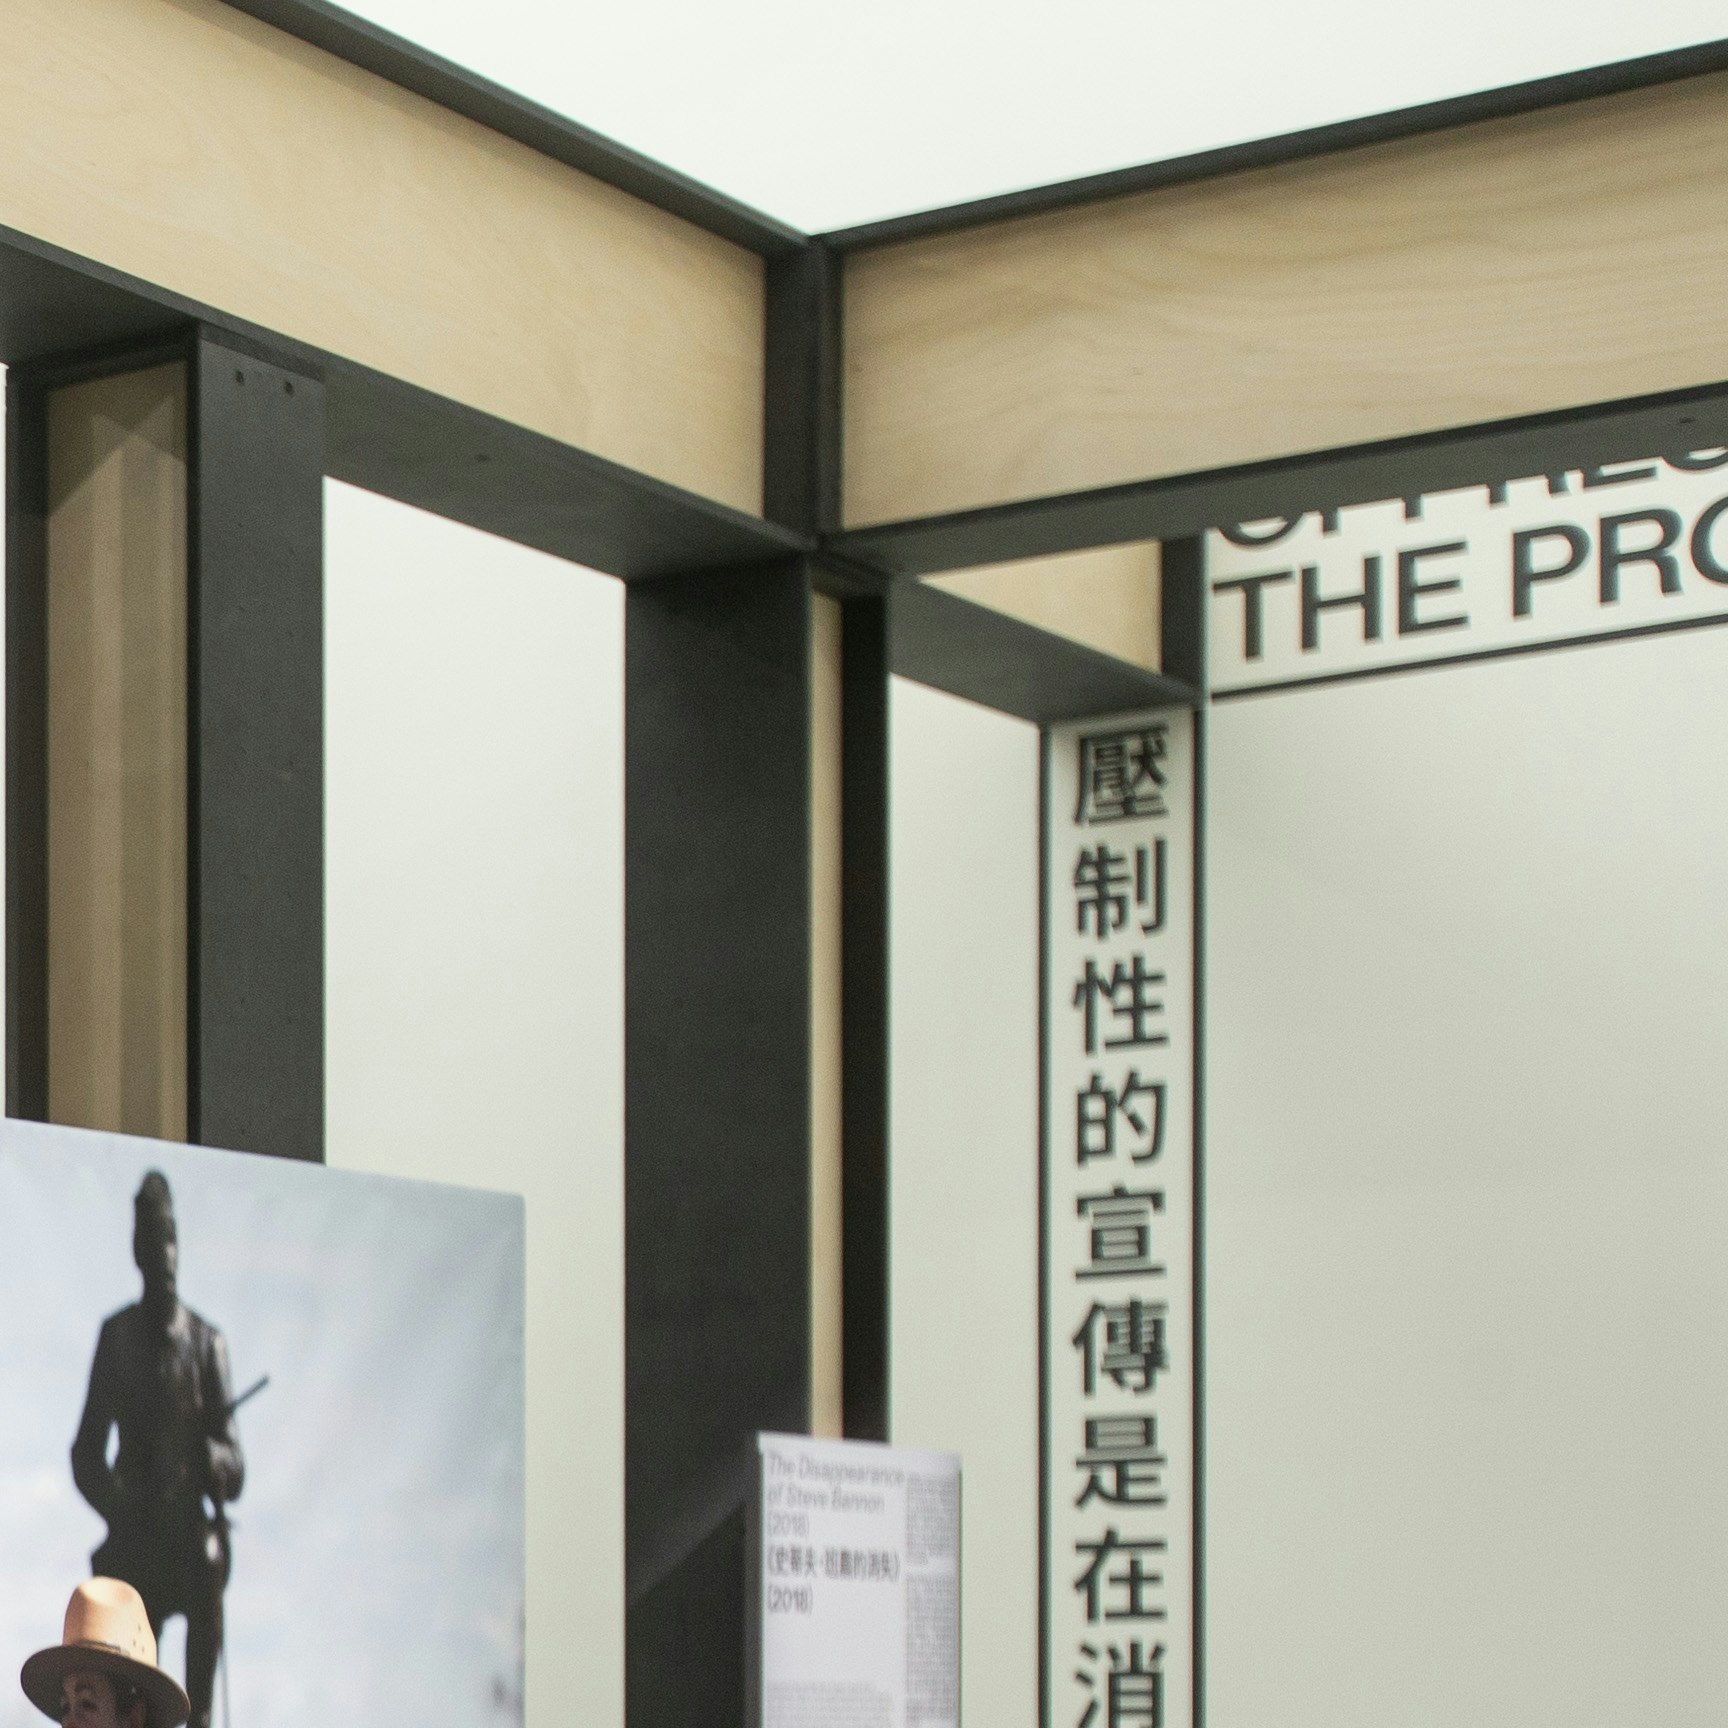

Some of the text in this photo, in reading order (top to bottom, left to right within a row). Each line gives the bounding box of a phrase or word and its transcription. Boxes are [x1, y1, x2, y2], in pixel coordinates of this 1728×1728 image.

[1212, 540, 1470, 664] THE
[769, 1452, 905, 1486] The Disappearance
[768, 1482, 885, 1514] of Steve Bannon
